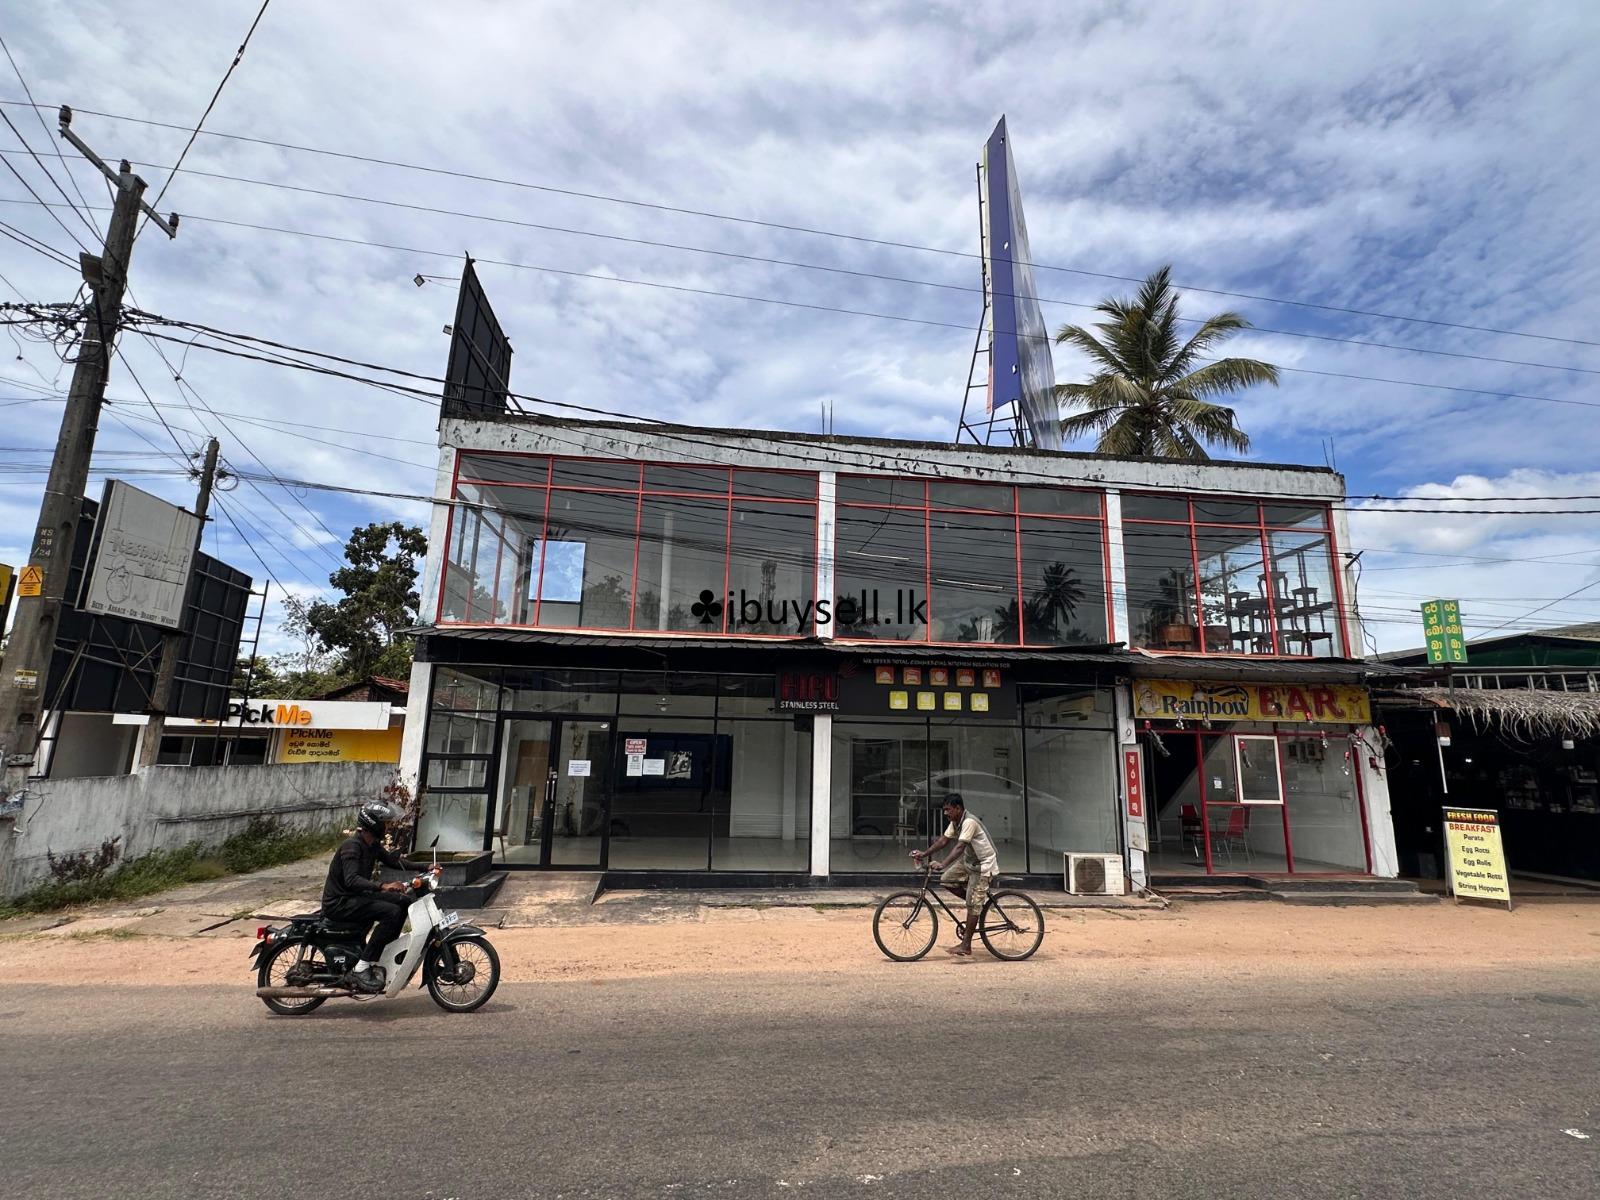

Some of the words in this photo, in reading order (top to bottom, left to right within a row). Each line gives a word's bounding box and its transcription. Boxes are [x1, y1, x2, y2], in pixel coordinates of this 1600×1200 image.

[780, 700, 817, 709] STAINLESS
[818, 701, 839, 710] STEEL
[1162, 694, 1249, 716] Rainbow
[1447, 811, 1472, 821] FRESH
[1473, 813, 1495, 823] FOOD
[1449, 823, 1496, 833] BREAKFAST
[1461, 846, 1473, 854] Egg
[1463, 858, 1475, 867] Egg
[1455, 869, 1486, 879] Vegetable
[1458, 881, 1477, 891] String
[1478, 884, 1504, 893] Hoppers
